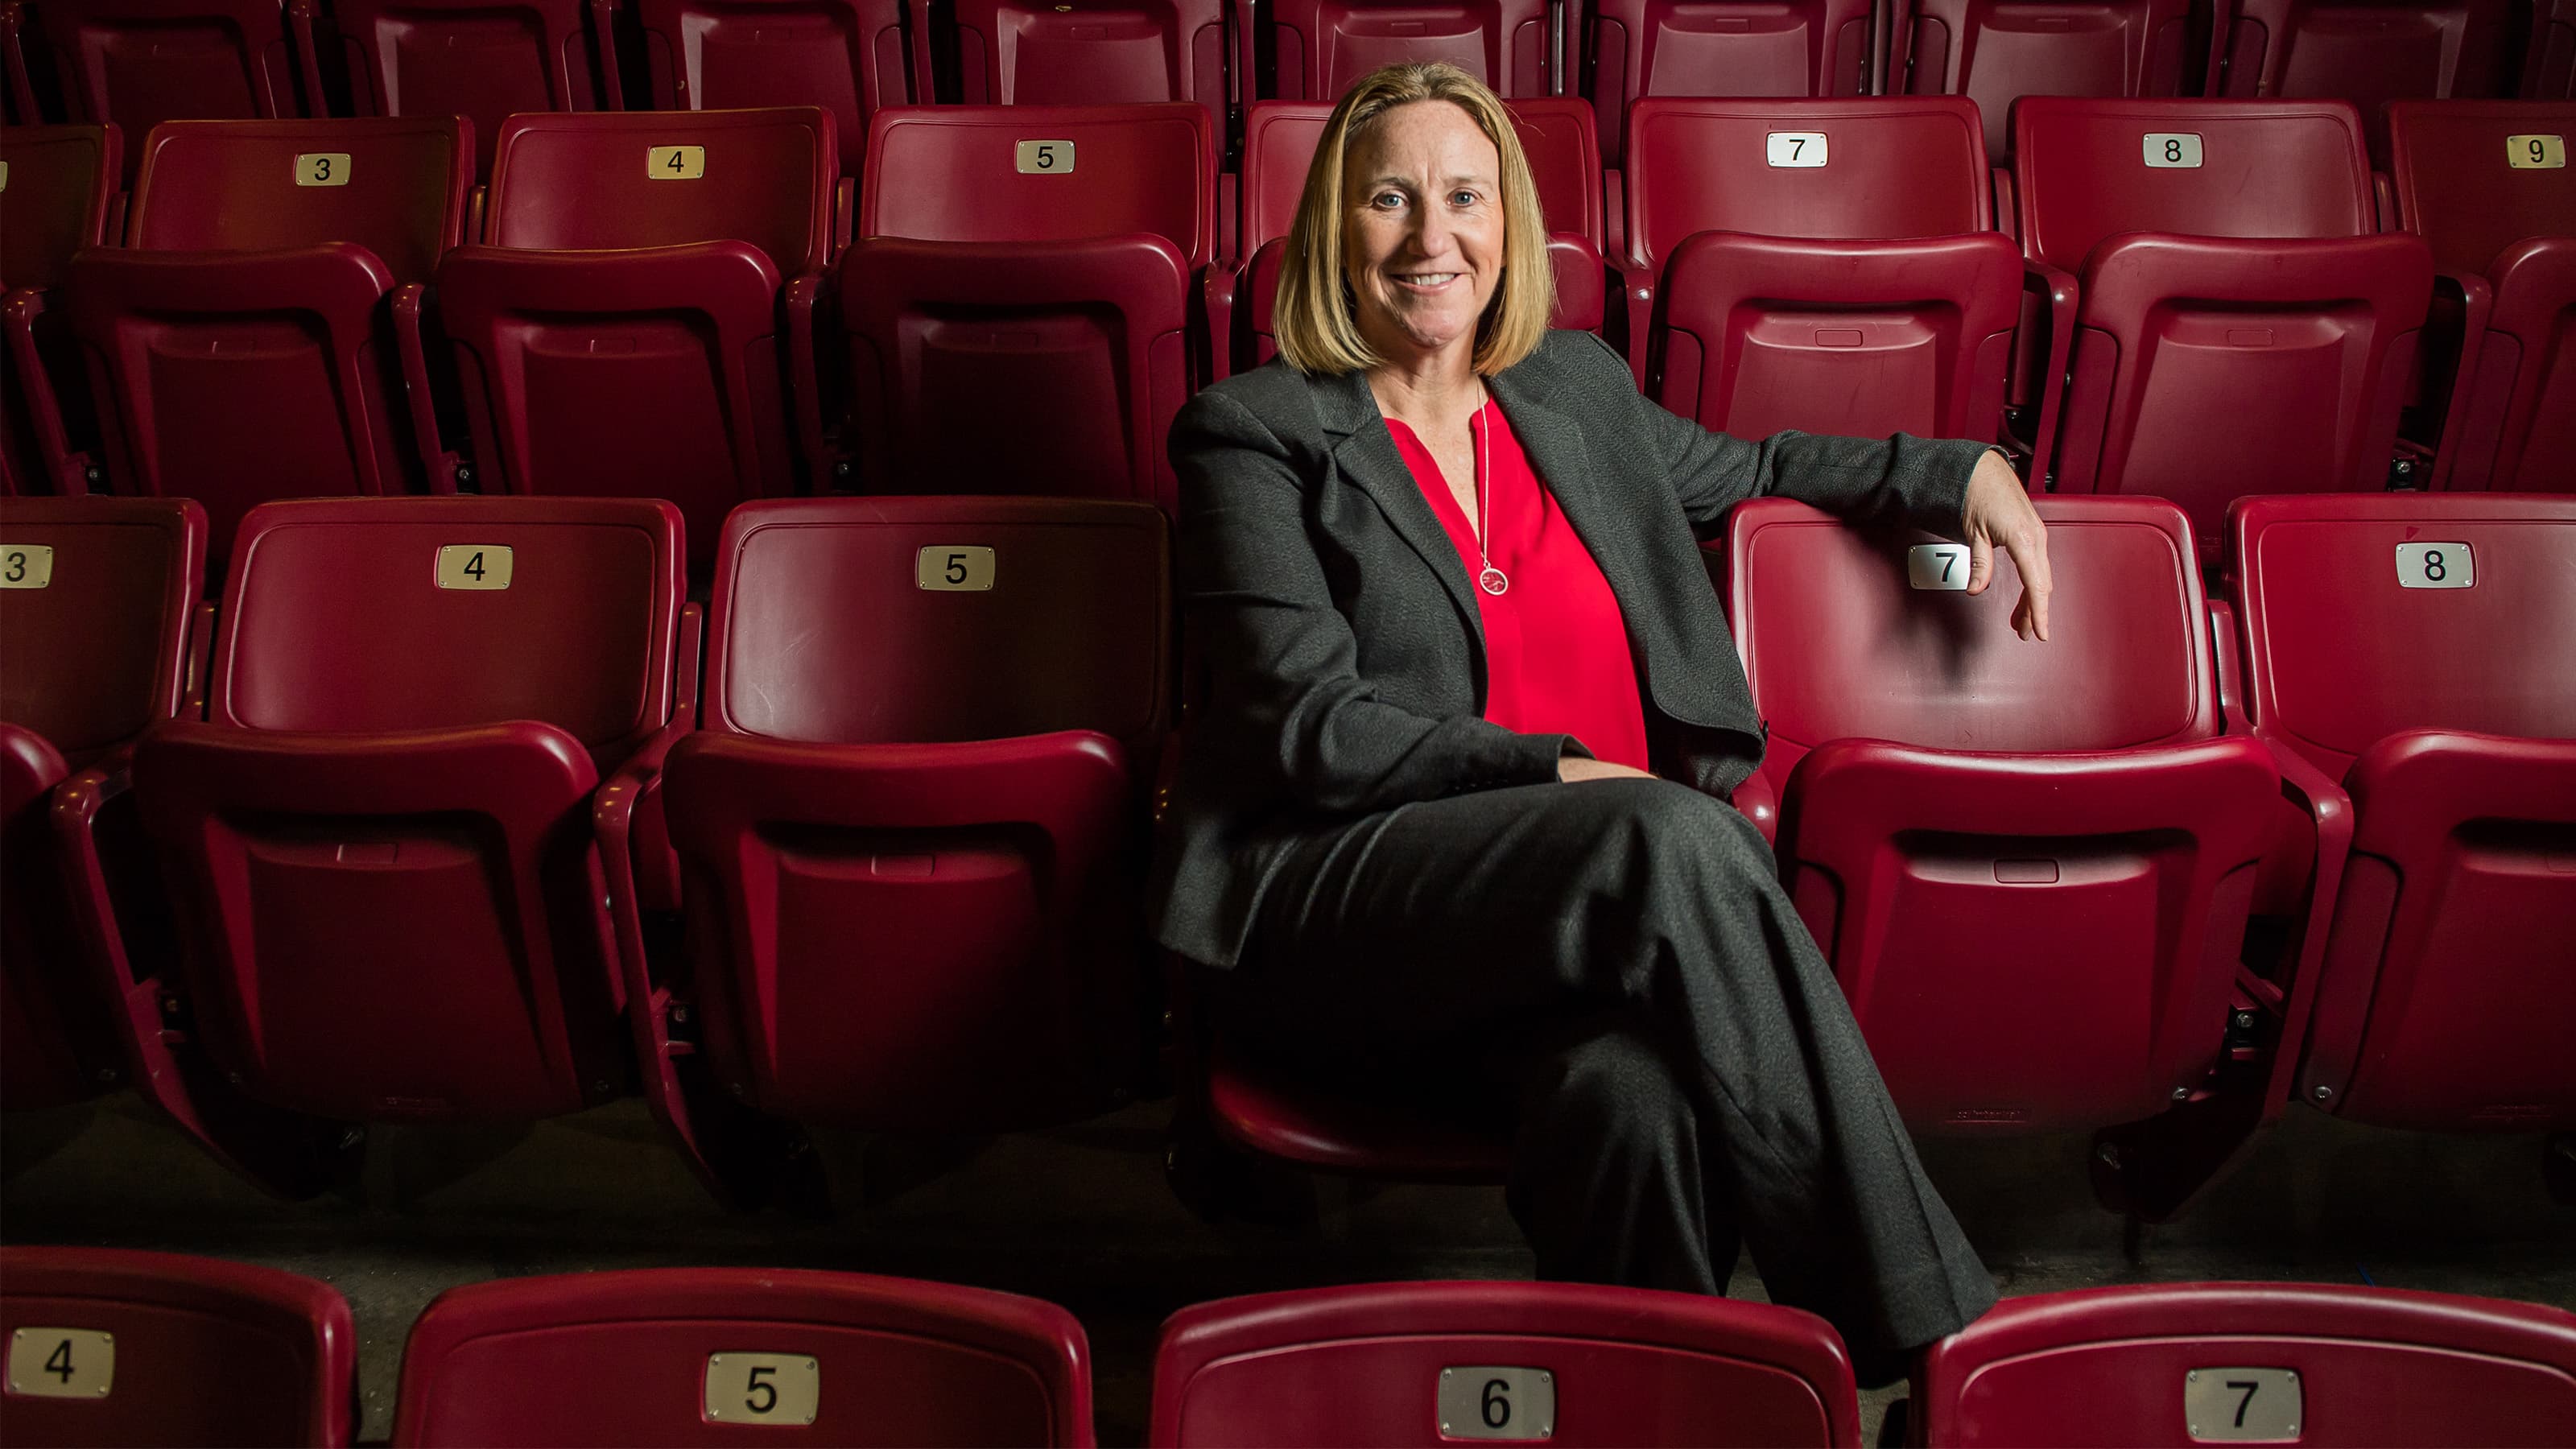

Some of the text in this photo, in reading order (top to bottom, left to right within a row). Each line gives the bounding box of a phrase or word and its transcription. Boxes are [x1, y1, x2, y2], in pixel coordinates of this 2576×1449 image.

[667, 151, 684, 173] 4
[1037, 146, 1054, 169] 5
[1789, 138, 1806, 161] 7
[2165, 138, 2182, 163] 8
[2529, 139, 2545, 163] 9
[314, 159, 331, 181] 3
[5, 551, 27, 582] 3
[463, 551, 486, 581] 4
[945, 553, 968, 584] 5
[1936, 552, 1957, 583] 7
[2424, 550, 2446, 580] 8
[44, 1339, 75, 1385] 4
[745, 1366, 778, 1414] 5
[1480, 1378, 1511, 1429] 6
[2226, 1381, 2259, 1428] 7
